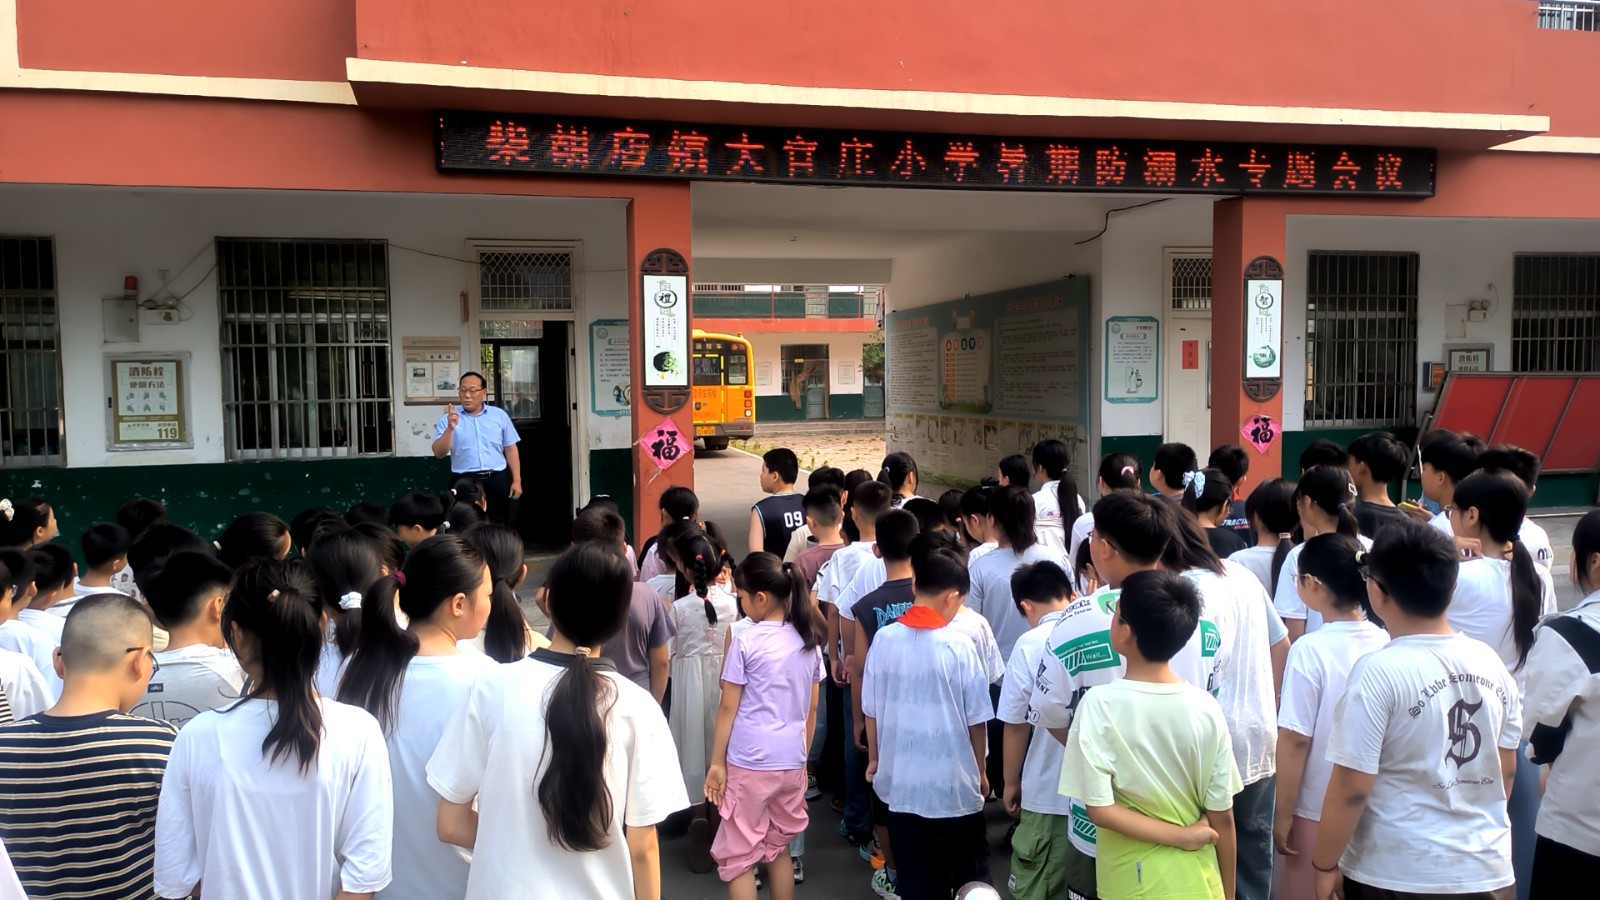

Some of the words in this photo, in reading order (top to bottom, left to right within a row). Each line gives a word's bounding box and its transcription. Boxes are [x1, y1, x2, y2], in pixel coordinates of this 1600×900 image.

[129, 367, 163, 376] 消防栓
[157, 428, 177, 438] 119
[1250, 417, 1274, 445] 福
[651, 429, 681, 461] 福
[783, 511, 804, 528] 09
[1448, 671, 1495, 691] Someone
